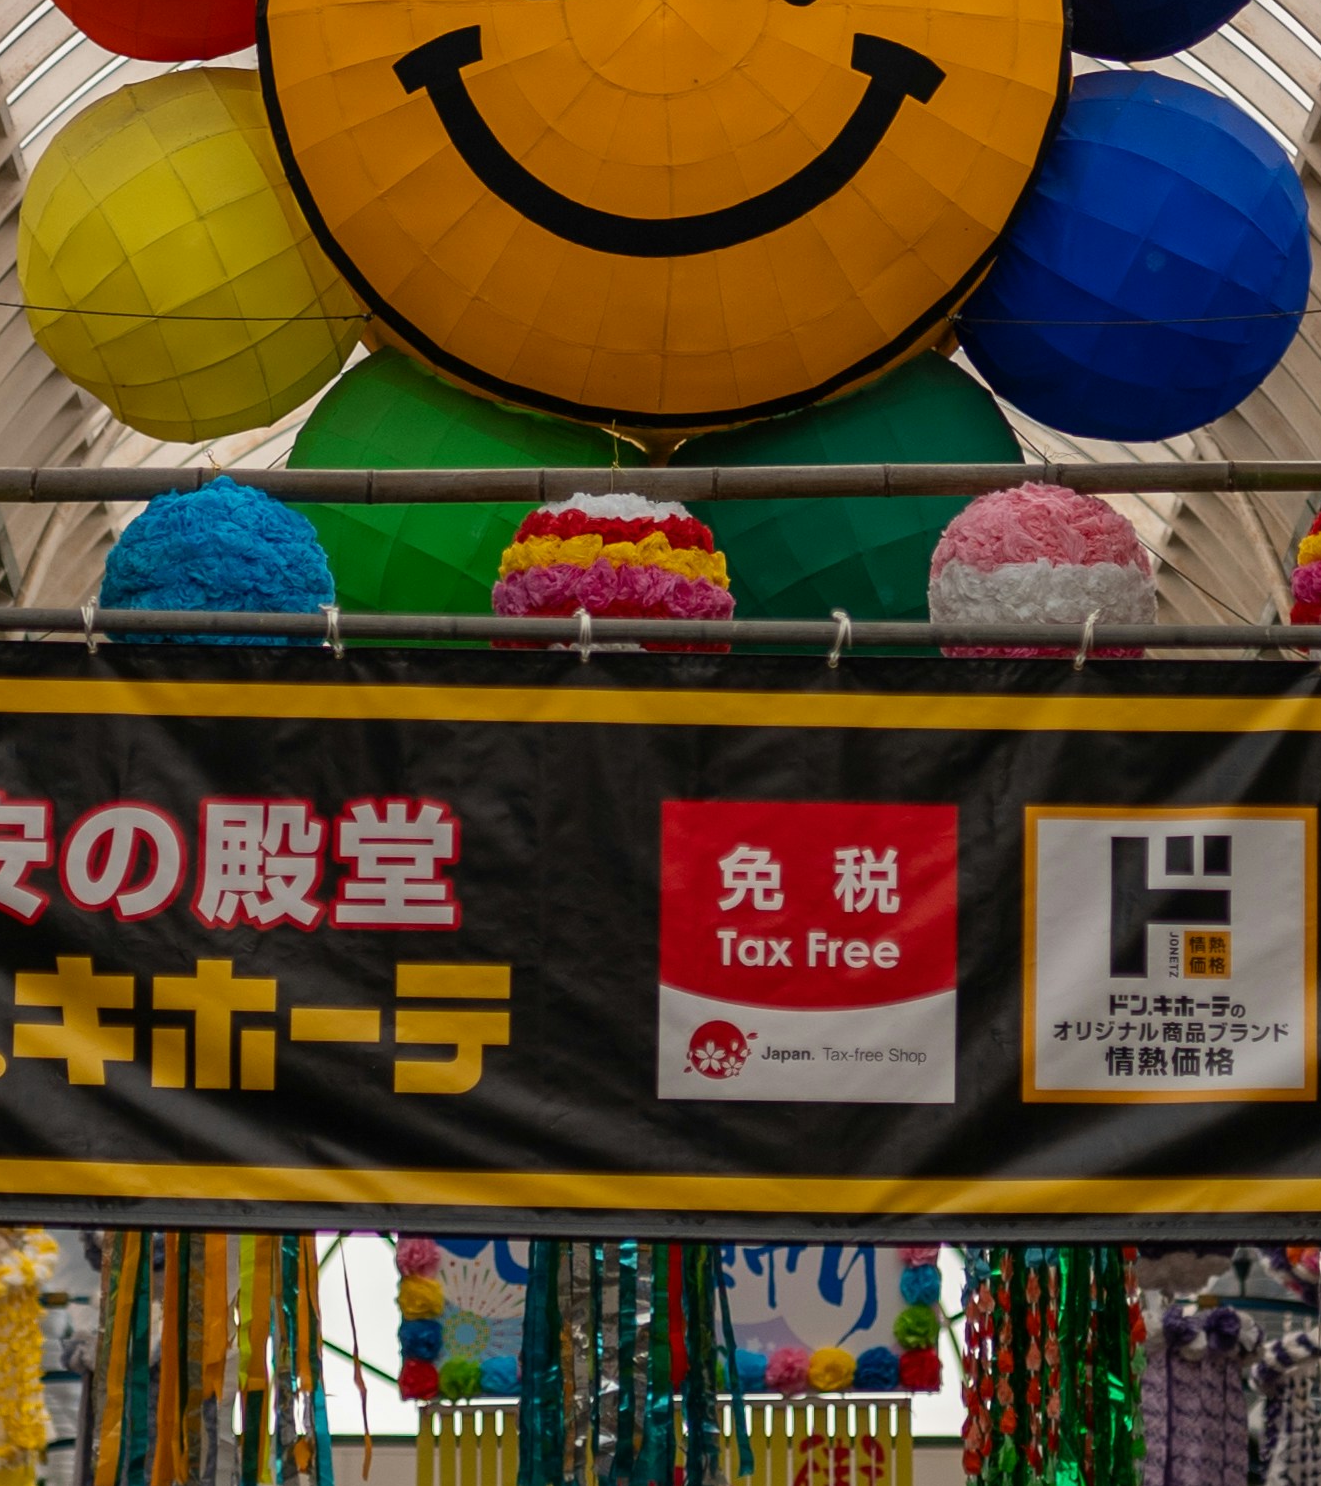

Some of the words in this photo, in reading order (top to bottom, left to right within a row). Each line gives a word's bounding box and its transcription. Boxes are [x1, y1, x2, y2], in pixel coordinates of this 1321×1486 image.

[717, 931, 793, 967] Tax
[808, 932, 901, 969] Free
[1168, 931, 1180, 979] JONETZ
[1053, 1021, 1289, 1044] オリジナル商品ブランド
[761, 1047, 815, 1063] Japan.
[823, 1047, 883, 1062] Tax-free
[889, 1048, 927, 1065] Shop
[1105, 1047, 1235, 1077] 情熱価格
